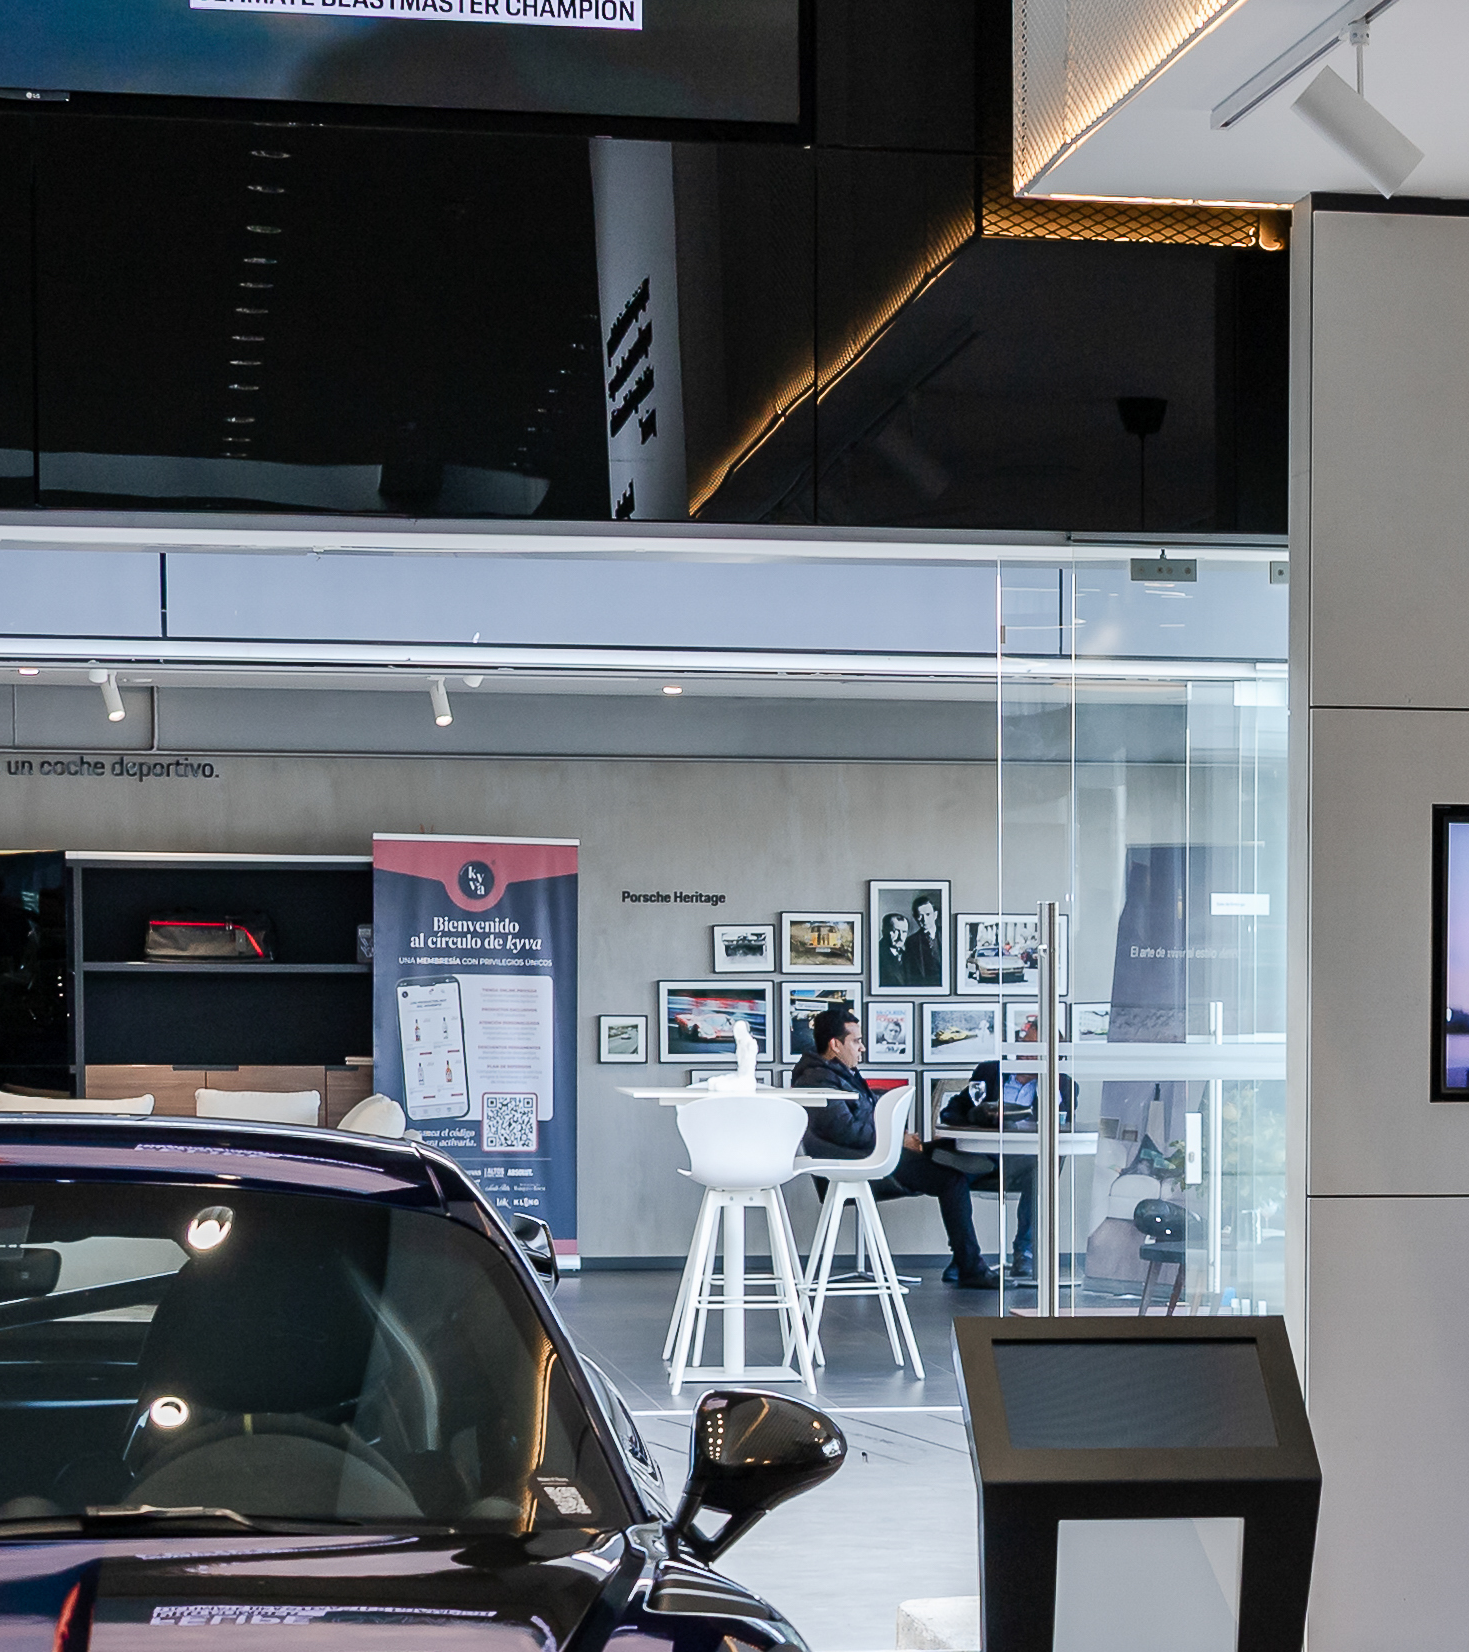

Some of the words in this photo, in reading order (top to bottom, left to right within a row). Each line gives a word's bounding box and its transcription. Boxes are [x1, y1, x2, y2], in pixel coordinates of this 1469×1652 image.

[505, 0, 635, 22] CHAMPION
[7, 759, 33, 776] un
[39, 756, 105, 777] coche
[111, 756, 220, 783] deportivo.
[621, 890, 671, 903] Porsche
[673, 891, 726, 907] Heritage
[433, 916, 519, 934] Bienvenido
[410, 932, 424, 949] al
[427, 932, 481, 949] círculo
[484, 933, 503, 950] de
[506, 934, 542, 954] kyva
[398, 956, 416, 965] UNA
[461, 957, 479, 966] CON
